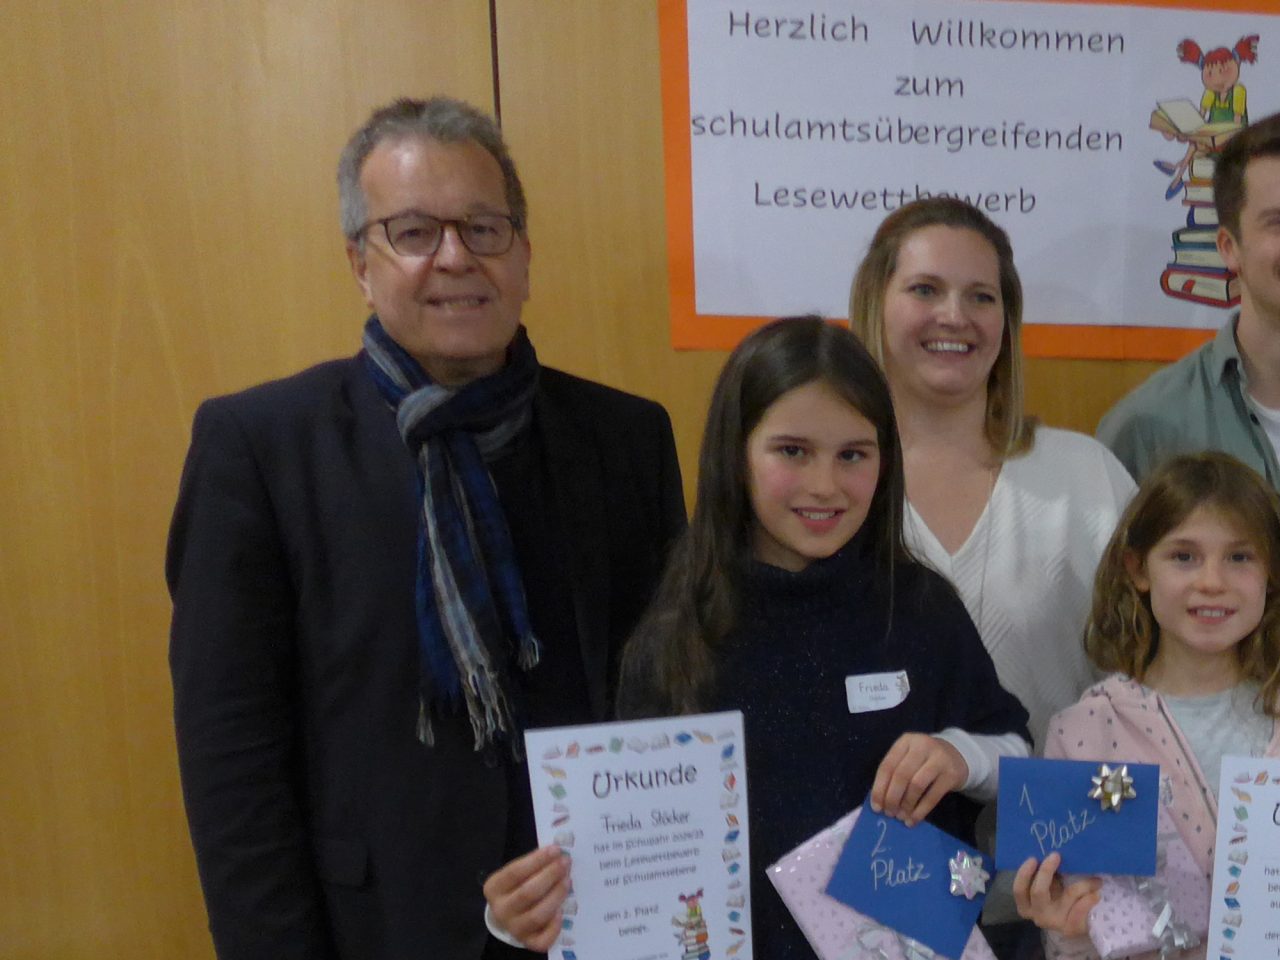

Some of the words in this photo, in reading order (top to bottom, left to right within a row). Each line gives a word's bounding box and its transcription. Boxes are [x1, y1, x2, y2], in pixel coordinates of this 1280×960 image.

[728, 11, 869, 43] Herzlich
[911, 19, 1126, 55] Willkommen
[894, 74, 964, 98] zum
[691, 111, 1123, 153] schulamtsübergreifenden
[592, 762, 698, 799] Urkunde
[1018, 783, 1035, 816] 1
[600, 812, 642, 833] Frieda
[1030, 809, 1096, 856] Platz
[870, 856, 930, 890] Platz
